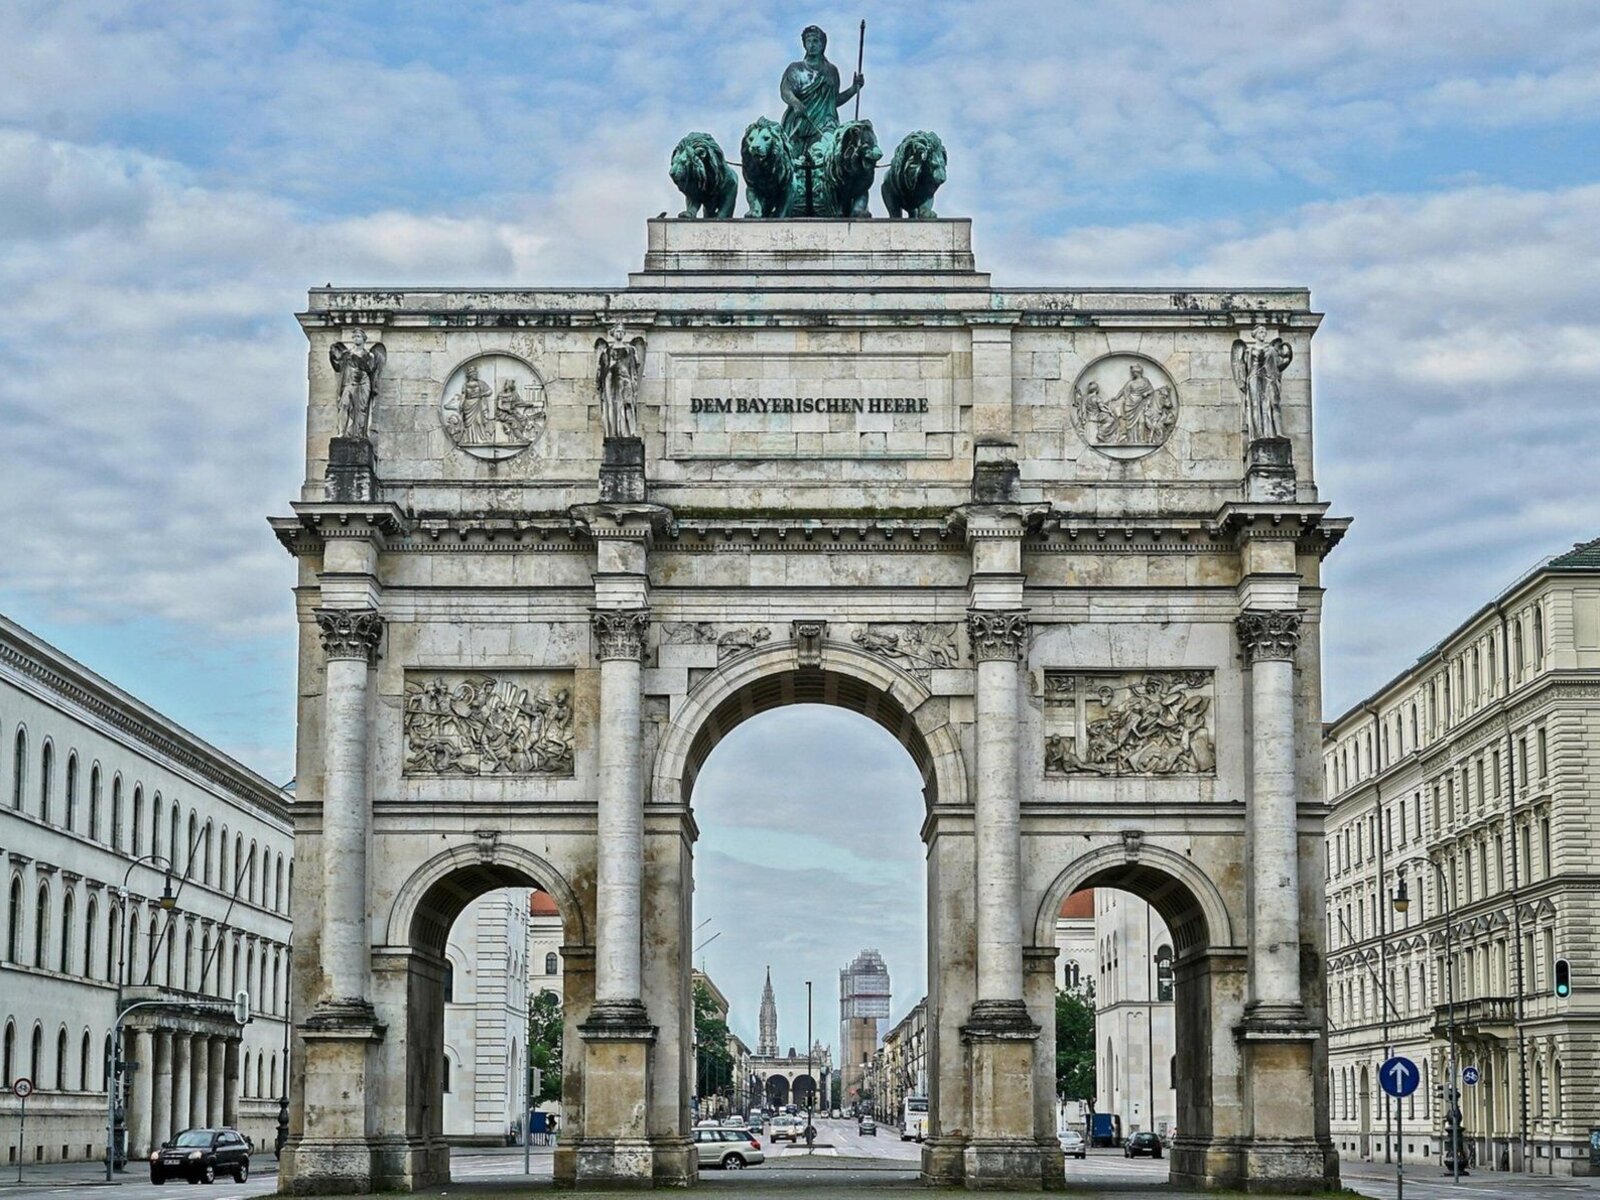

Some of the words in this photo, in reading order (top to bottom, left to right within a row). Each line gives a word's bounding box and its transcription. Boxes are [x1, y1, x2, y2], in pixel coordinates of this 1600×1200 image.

[690, 397, 733, 414] DEM
[735, 397, 864, 414] BAYERISCHEN
[867, 397, 929, 414] HEERE
